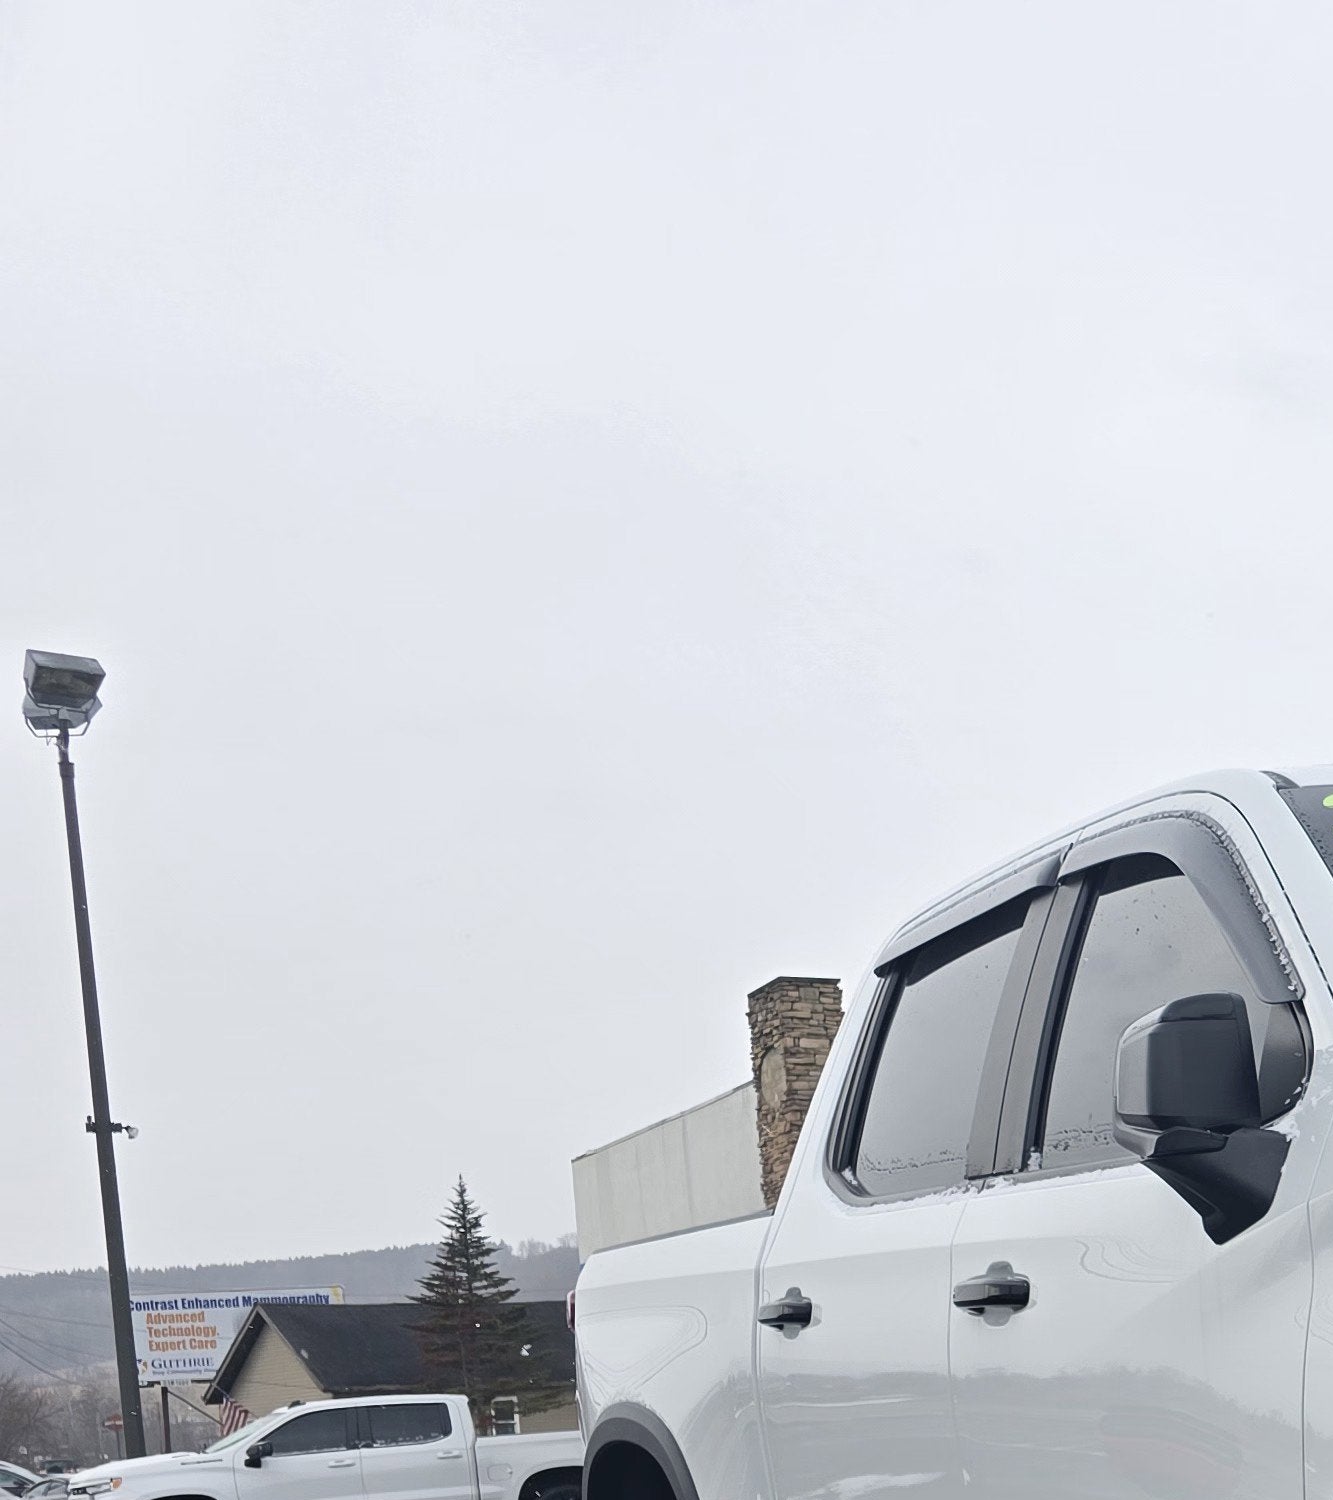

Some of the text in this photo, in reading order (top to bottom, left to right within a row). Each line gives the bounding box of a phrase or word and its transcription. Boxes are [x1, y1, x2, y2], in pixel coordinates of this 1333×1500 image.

[181, 1296, 240, 1309] Enhanced
[146, 1311, 205, 1325] Advanced
[146, 1324, 219, 1338] Technology.
[148, 1337, 217, 1353] Expert Care
